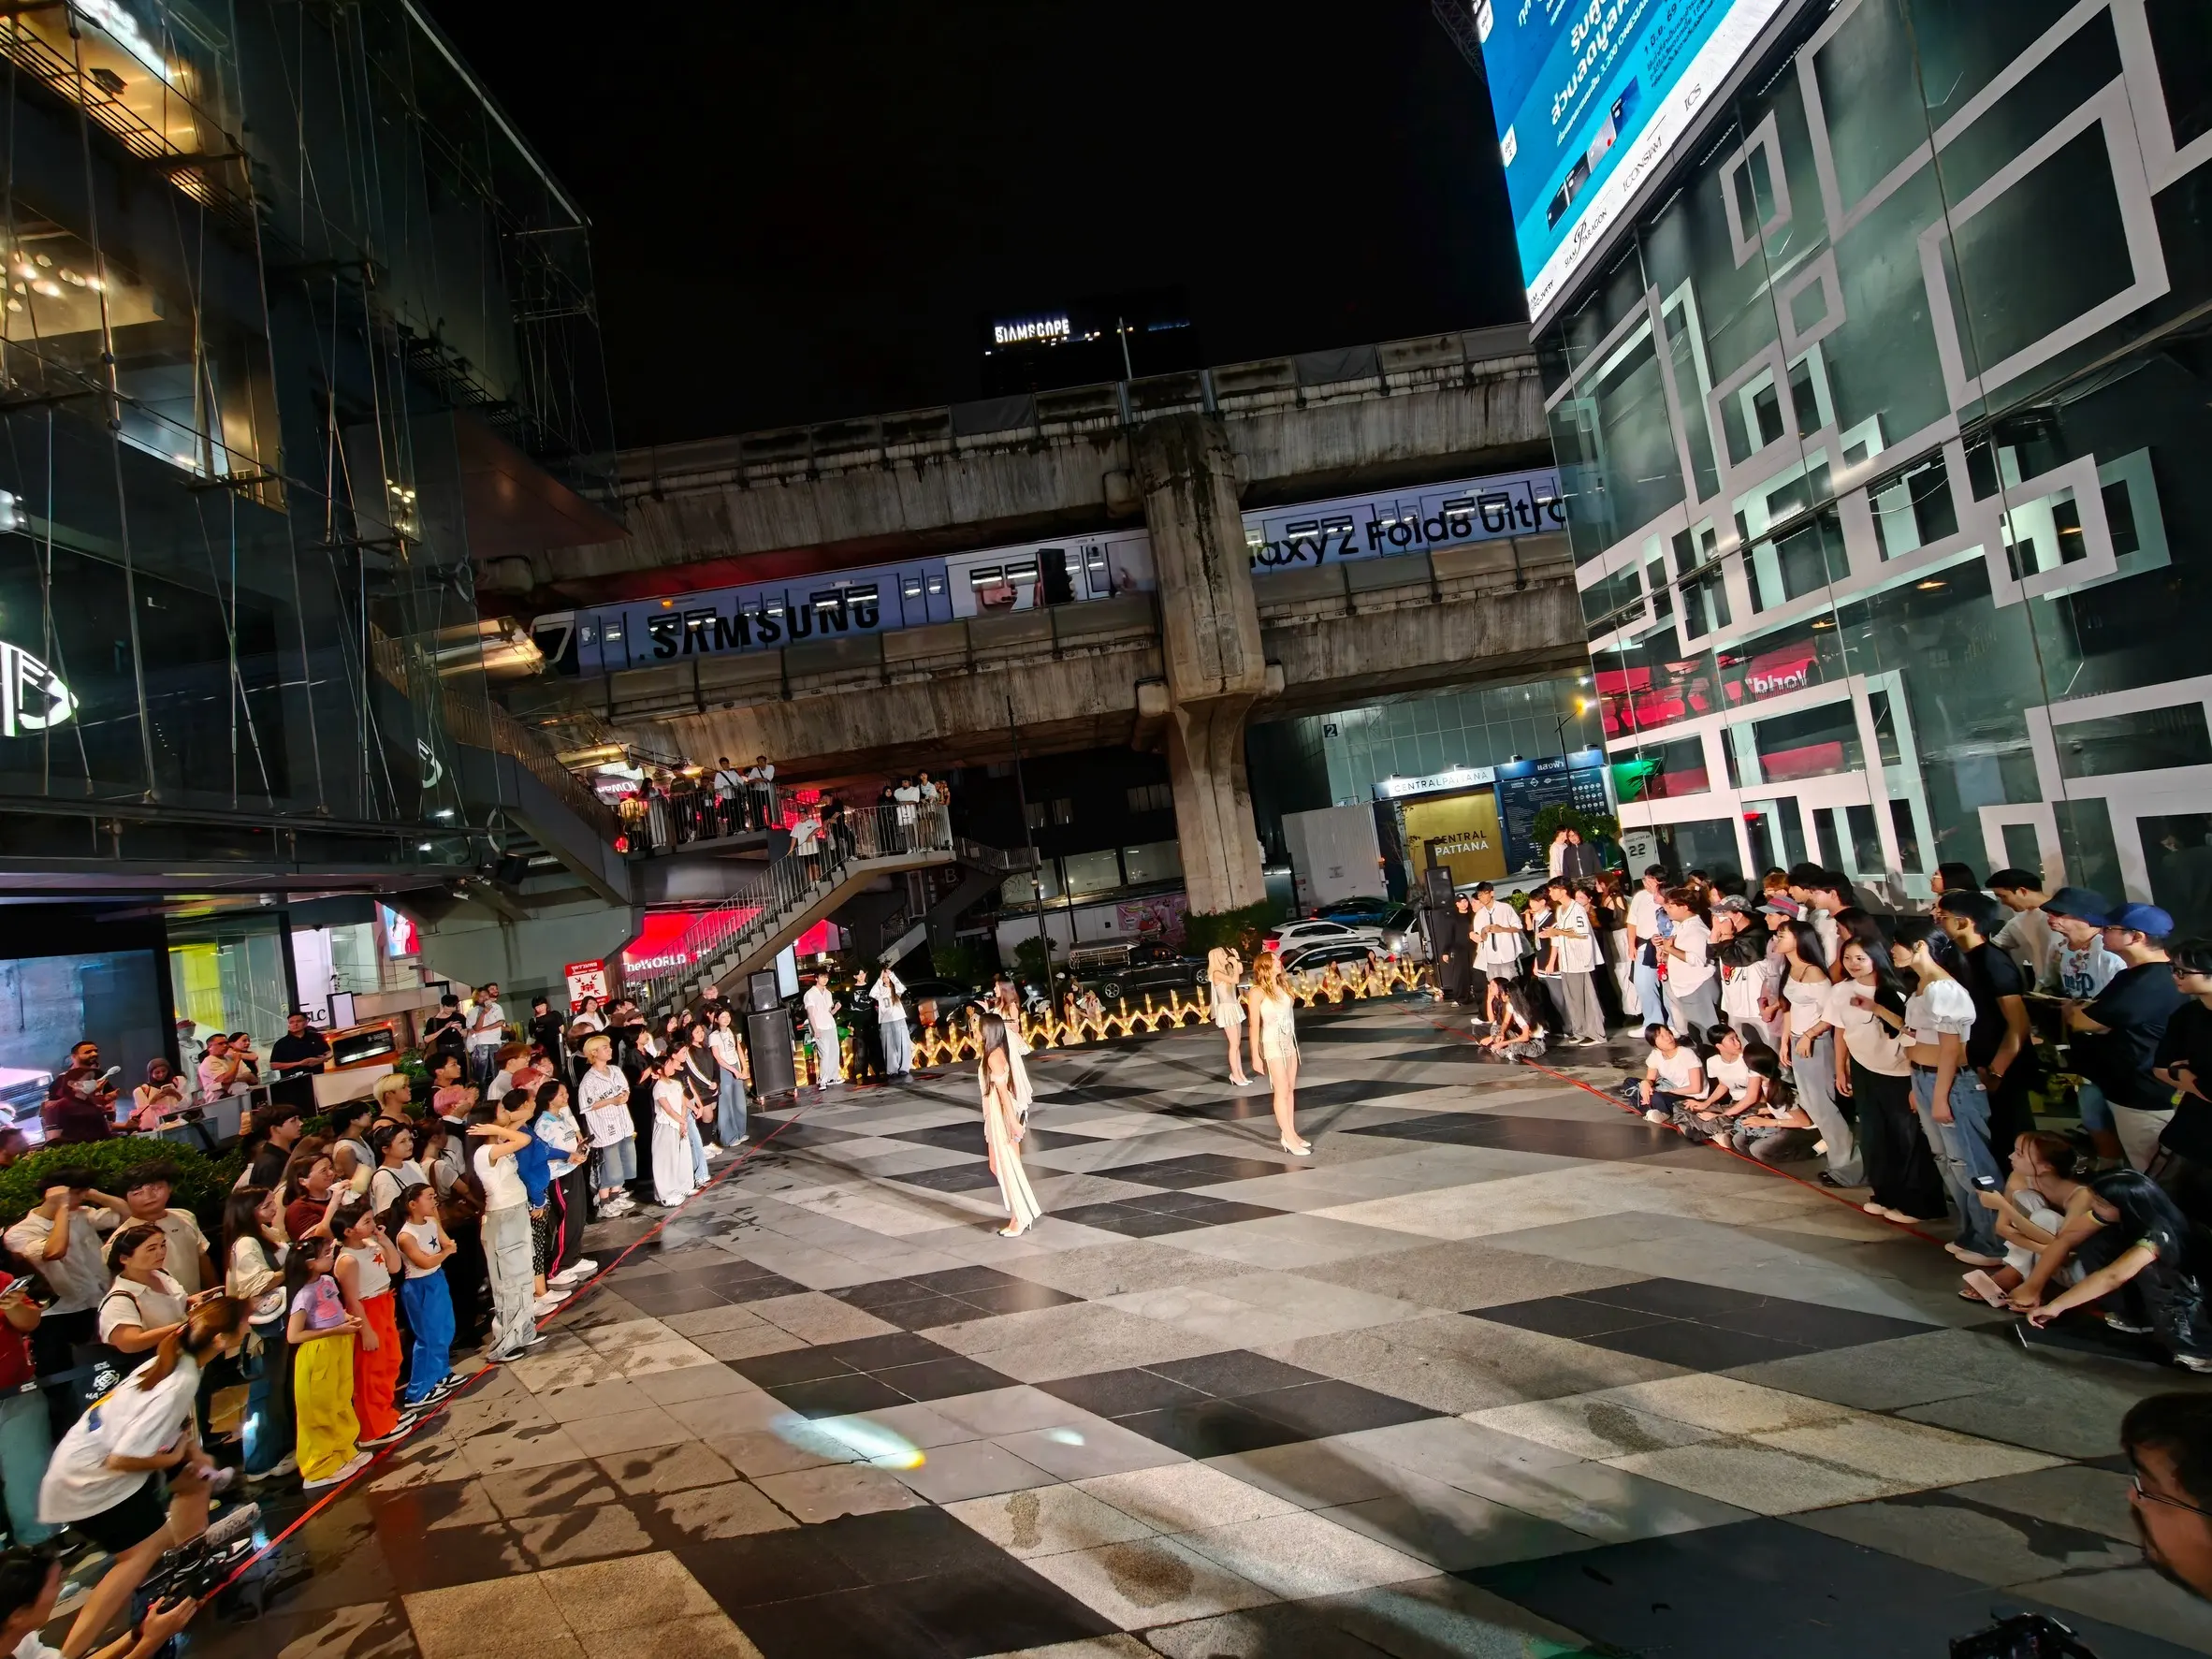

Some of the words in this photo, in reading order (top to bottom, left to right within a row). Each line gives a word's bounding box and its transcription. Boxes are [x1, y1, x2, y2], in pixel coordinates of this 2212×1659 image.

[1684, 82, 1702, 112] ICS
[652, 604, 880, 660] SAMSUNG
[1326, 724, 1336, 737] 2
[1433, 829, 1488, 846] CENTRAL
[1434, 839, 1490, 857] PATTANA
[1628, 842, 1647, 857] 22
